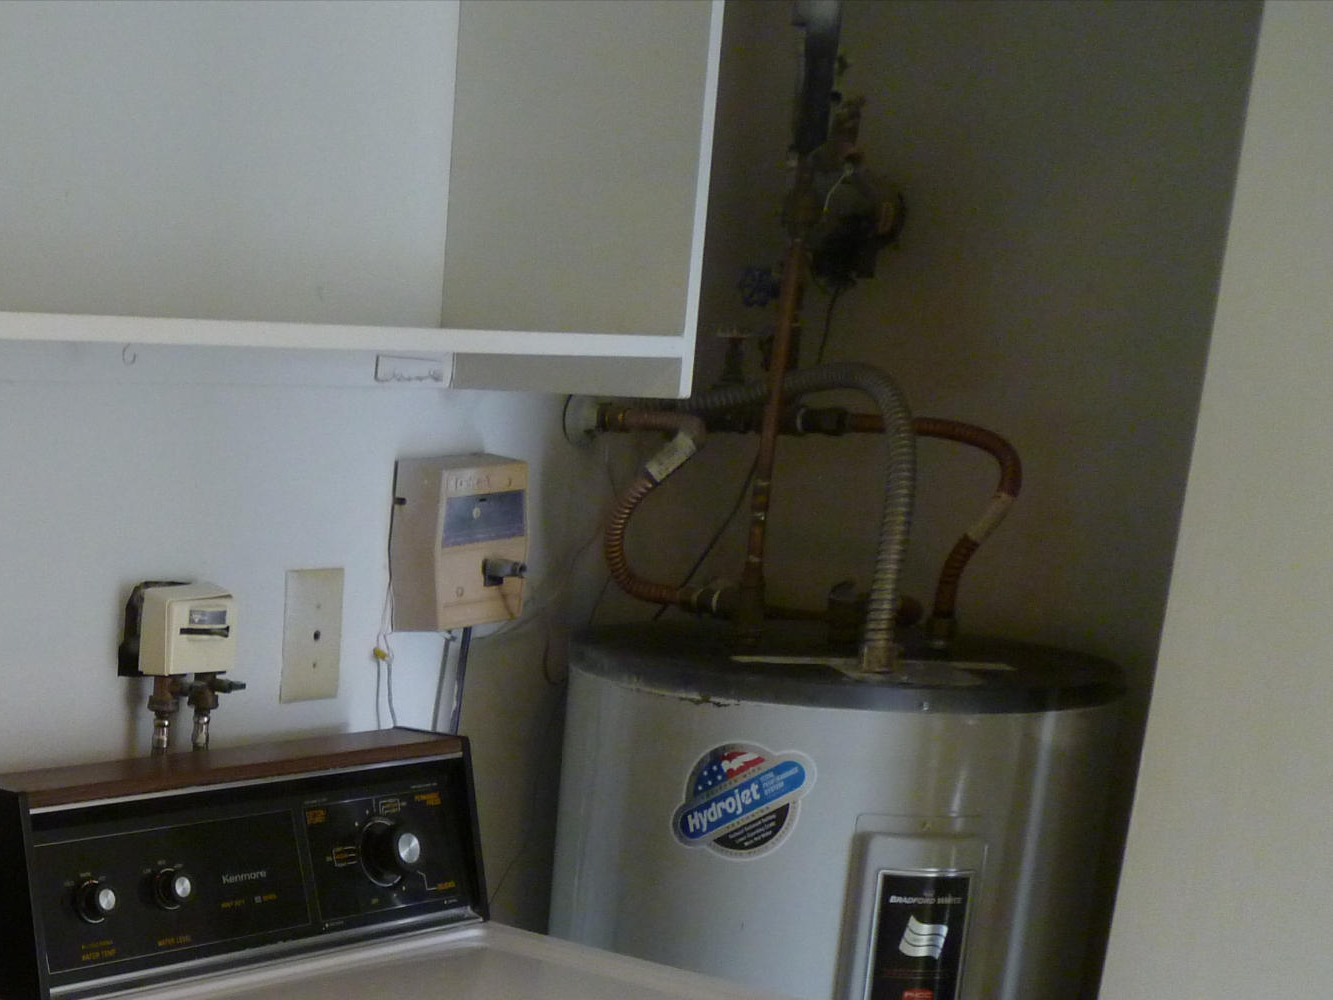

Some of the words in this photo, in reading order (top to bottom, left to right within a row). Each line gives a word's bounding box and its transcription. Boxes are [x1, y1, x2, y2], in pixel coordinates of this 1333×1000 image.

[687, 782, 761, 833] Hydrojet
[221, 870, 267, 885] Kenmore
[889, 895, 936, 905] BRADFORD
